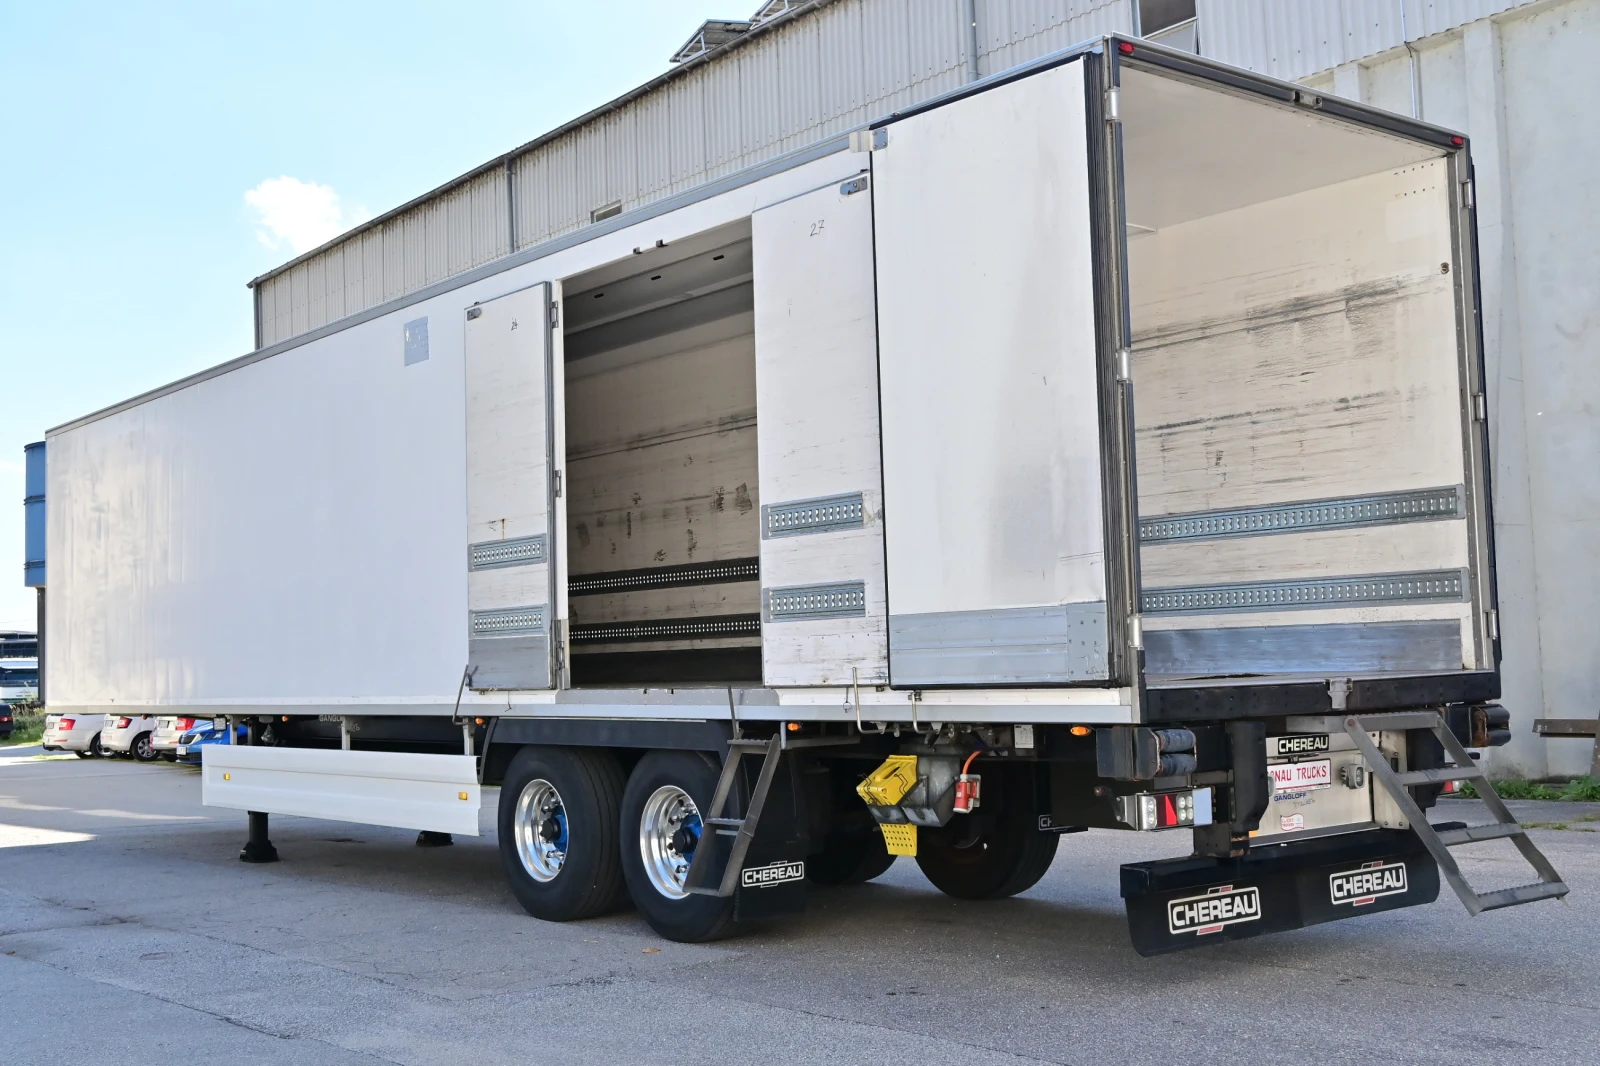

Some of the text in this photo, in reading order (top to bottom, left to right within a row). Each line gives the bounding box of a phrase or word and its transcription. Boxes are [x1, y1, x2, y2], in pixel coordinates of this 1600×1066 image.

[810, 219, 825, 237] 27
[1278, 737, 1328, 752] CHEREAU
[1271, 765, 1327, 782] NAU TRUCKS
[1274, 792, 1306, 801] GANGLOFF
[744, 865, 801, 883] CHEREAU
[1333, 868, 1404, 898] CHEREAU
[1172, 893, 1257, 927] CHEREAU
